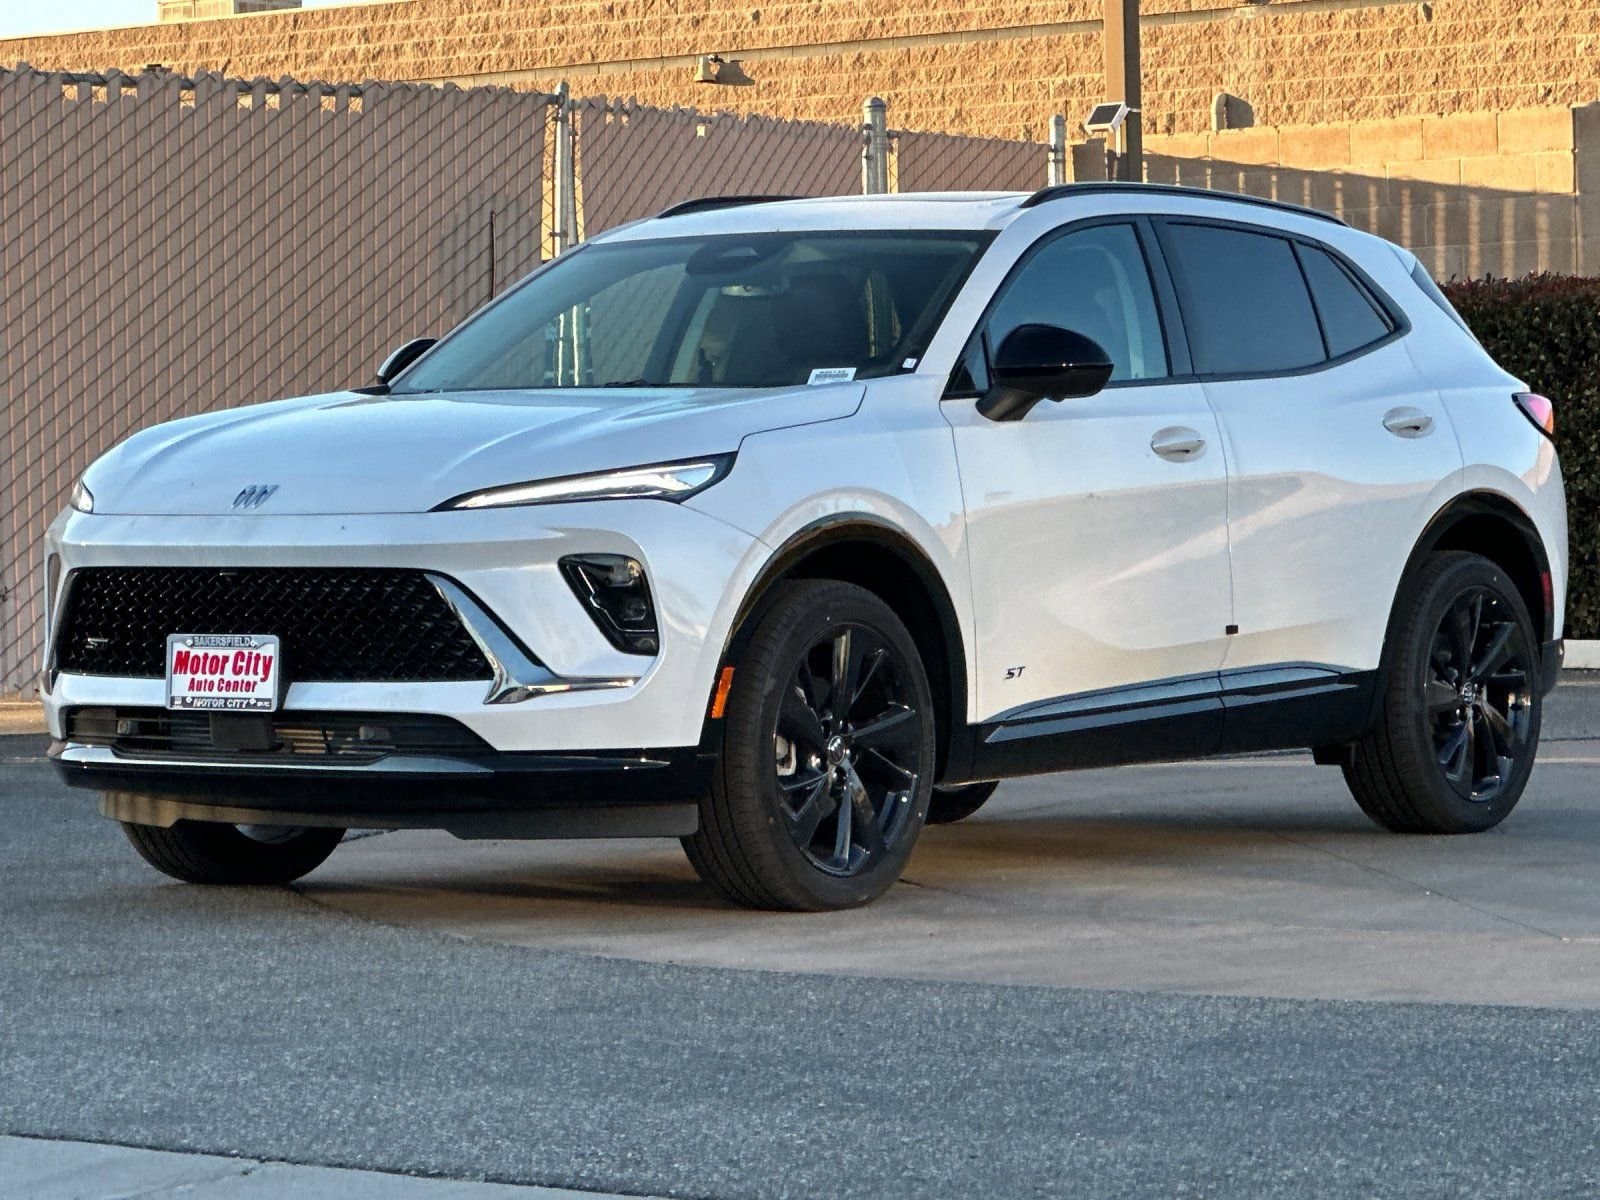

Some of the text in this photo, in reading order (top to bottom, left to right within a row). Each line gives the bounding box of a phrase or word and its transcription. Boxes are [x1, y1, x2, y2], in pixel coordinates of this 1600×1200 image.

[194, 636, 250, 647] BAKERSFIELD
[173, 651, 273, 682] Motor City
[1004, 666, 1026, 680] ST
[188, 678, 258, 693] Auto Center
[192, 698, 225, 708] MOTOR
[227, 699, 249, 708] CITY
